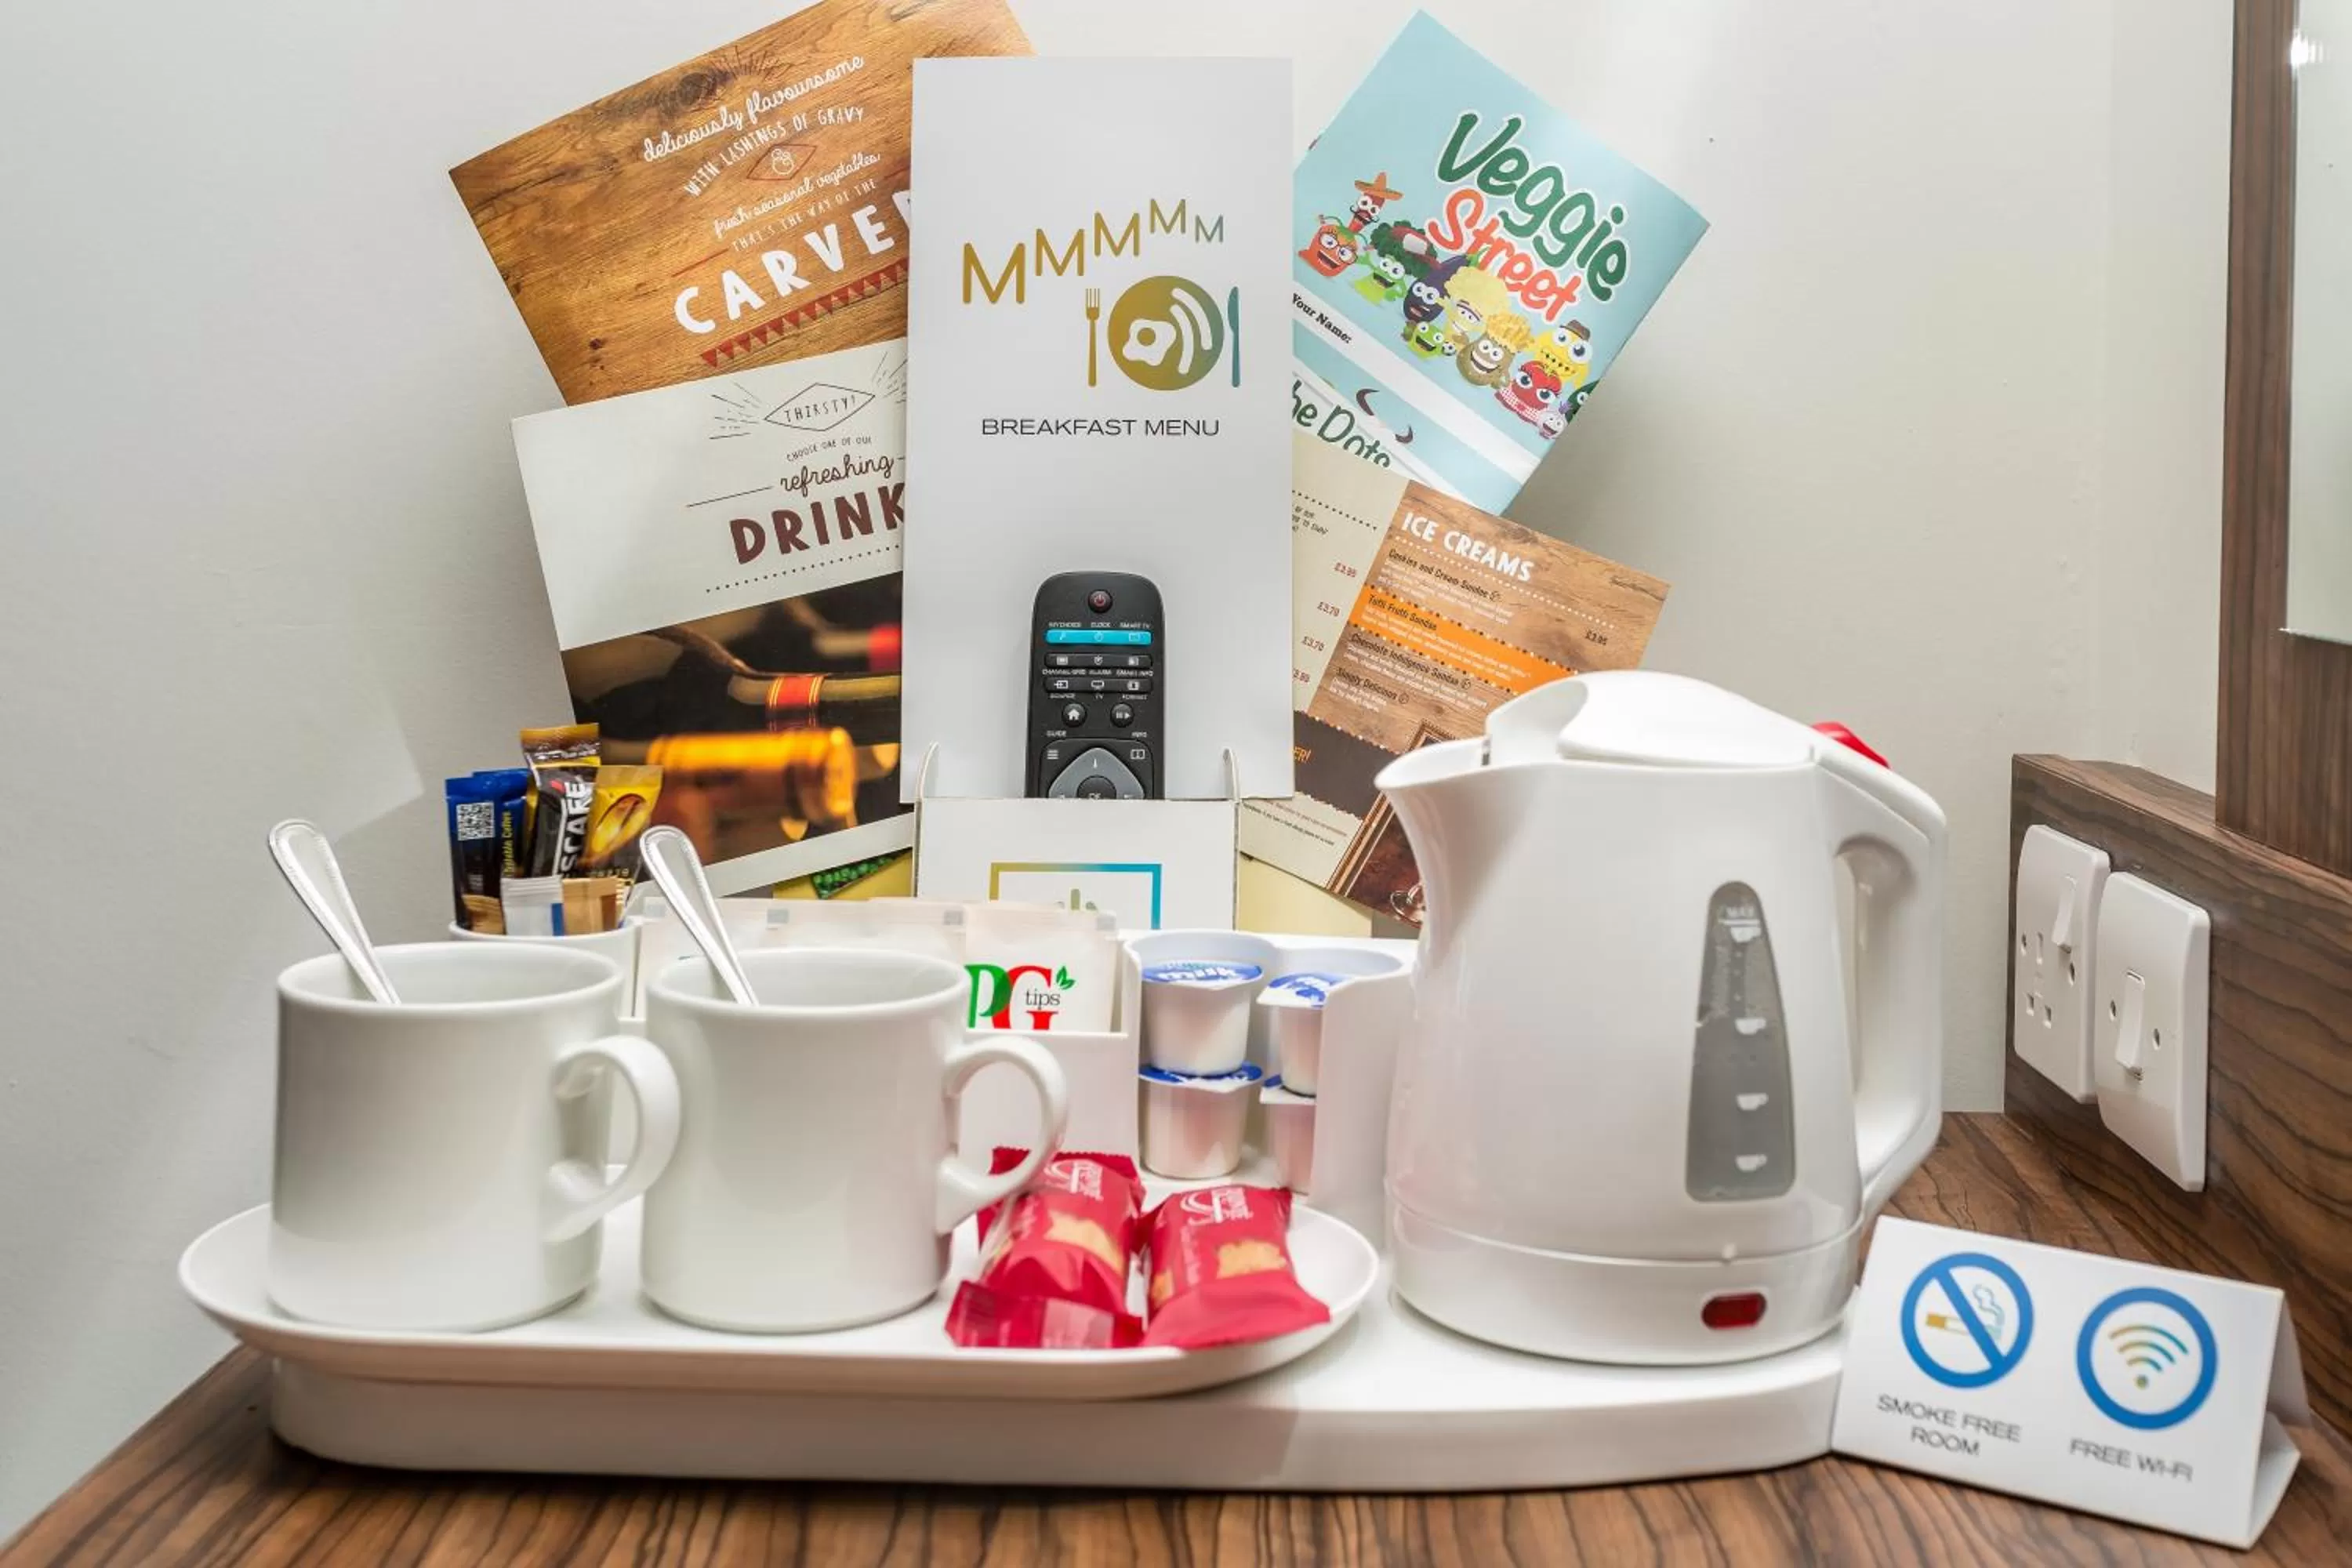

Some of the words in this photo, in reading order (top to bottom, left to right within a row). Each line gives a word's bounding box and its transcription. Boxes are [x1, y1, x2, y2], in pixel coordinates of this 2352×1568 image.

[644, 107, 743, 162] deliciously
[746, 56, 865, 125] flavoursome
[684, 161, 720, 197] WITH
[720, 120, 787, 167] LASHINGS
[793, 113, 808, 131] OF
[818, 107, 863, 125] GRAVY
[1437, 113, 1627, 302] Veggie
[1426, 188, 1583, 322] Street
[1293, 292, 1316, 317] Your
[1316, 313, 1352, 344] Name:
[982, 419, 1137, 436] BREAKFAST
[1145, 419, 1220, 436] MENU
[780, 454, 895, 497] refreshing
[1401, 511, 1439, 543] ICE
[1443, 531, 1534, 582] CREAMS
[964, 964, 1060, 1030] PG
[1025, 988, 1062, 1011] tips
[1877, 1392, 1958, 1428] SMOKE
[1962, 1413, 2022, 1443] FREE
[1910, 1425, 1980, 1457] ROOM
[2069, 1438, 2132, 1469] FREE
